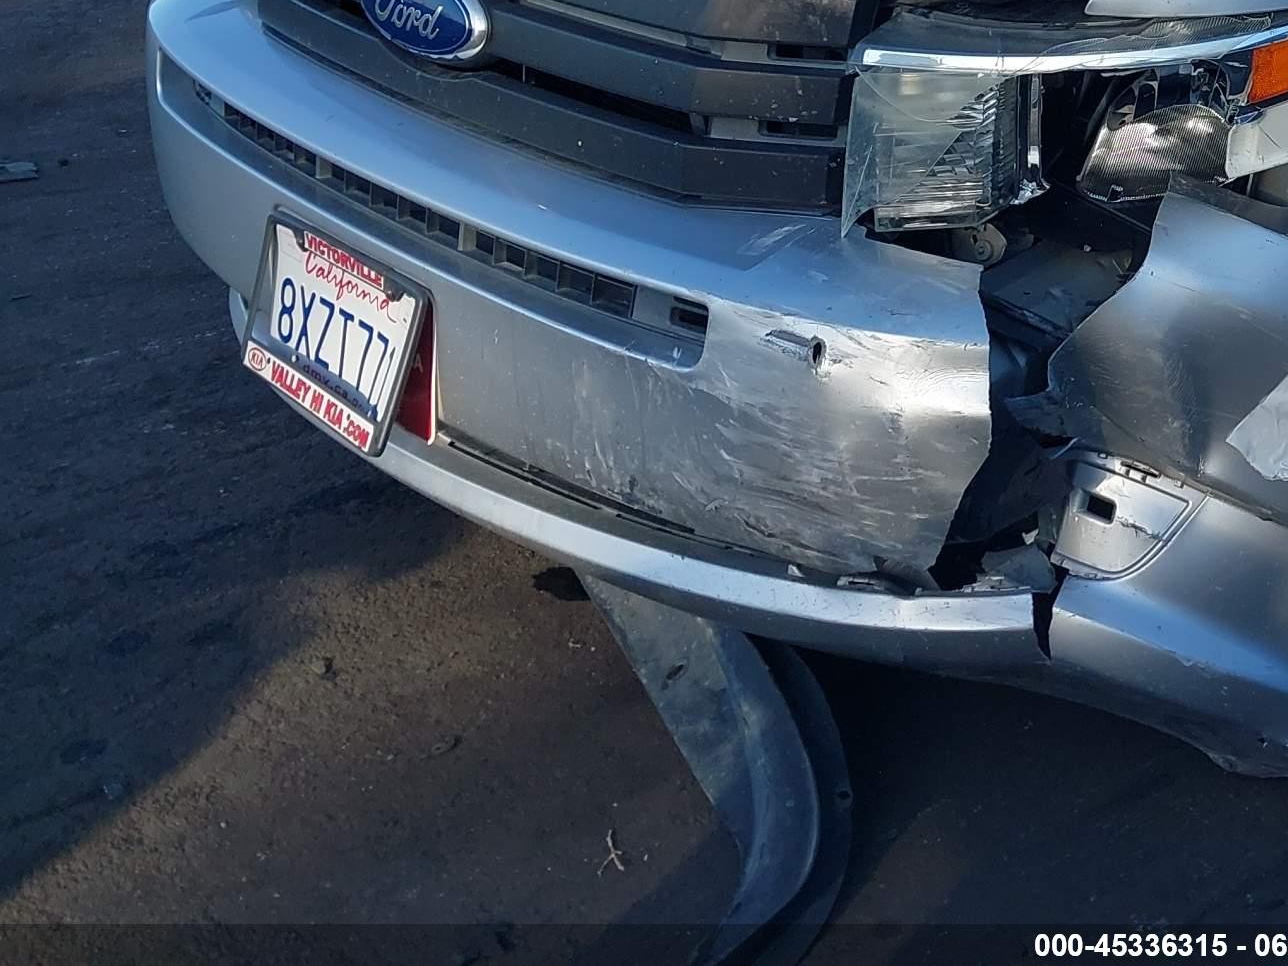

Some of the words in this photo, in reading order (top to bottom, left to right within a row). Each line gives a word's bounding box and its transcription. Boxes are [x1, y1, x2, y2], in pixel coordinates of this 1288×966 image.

[306, 233, 384, 289] VICTORVILLE
[306, 251, 396, 323] California
[250, 350, 263, 368] KIA
[271, 361, 312, 404] VALLEY
[310, 389, 325, 414] HI
[323, 397, 344, 430] KIA
